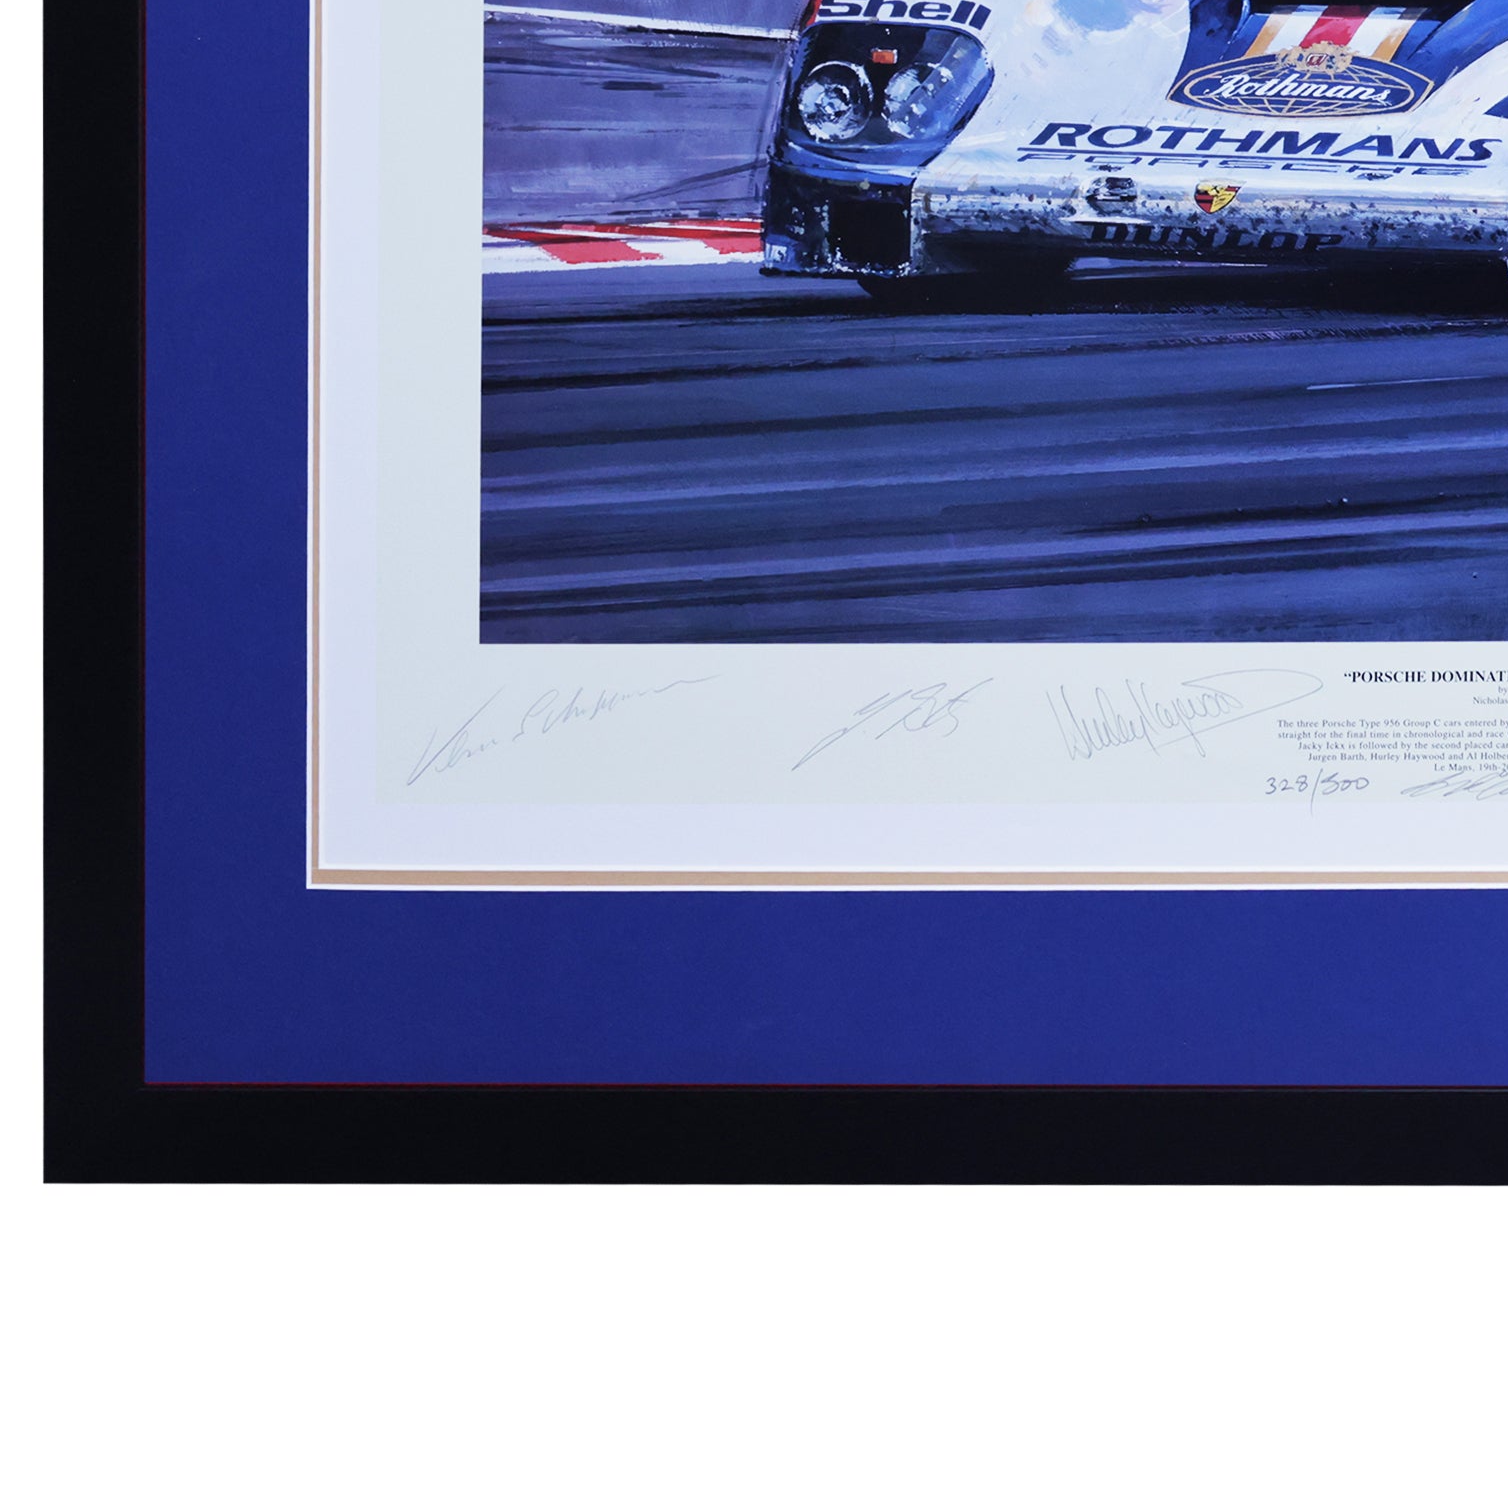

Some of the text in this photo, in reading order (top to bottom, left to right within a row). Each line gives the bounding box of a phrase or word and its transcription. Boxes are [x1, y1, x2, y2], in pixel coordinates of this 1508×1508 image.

[1204, 71, 1391, 105] Rothmans
[1029, 122, 1503, 161] ROTHMANS
[1016, 153, 1474, 176] PORSCHE
[1088, 223, 1344, 252] DUNLOP
[1498, 686, 1508, 695] by
[1472, 696, 1508, 705] Nicholas
[1277, 719, 1294, 728] The
[1297, 719, 1318, 728] three
[1322, 719, 1356, 728] Porsche
[1359, 719, 1380, 730] Type
[1384, 719, 1400, 728] 956
[1403, 719, 1431, 730] Group
[1433, 719, 1441, 728] C
[1464, 719, 1496, 728] entered
[1278, 730, 1311, 741] straight
[1314, 730, 1327, 739] for
[1330, 730, 1343, 739] the
[1346, 730, 1366, 739] final
[1370, 731, 1389, 739] time
[1392, 730, 1401, 739] in
[1404, 730, 1464, 741] chronological
[1467, 730, 1483, 738] and
[1298, 741, 1322, 752] Jacky
[1326, 741, 1345, 750] Ickx
[1348, 741, 1355, 749] is
[1359, 741, 1397, 750] followed
[1401, 741, 1411, 752] by
[1415, 741, 1428, 750] the
[1431, 741, 1461, 749] second
[1464, 741, 1493, 752] placed
[1308, 752, 1337, 763] Jurgen
[1371, 752, 1400, 763] Hurley
[1404, 752, 1445, 762] Haywood
[1448, 752, 1463, 760] and
[1467, 752, 1477, 760] Al
[1434, 763, 1445, 772] Le
